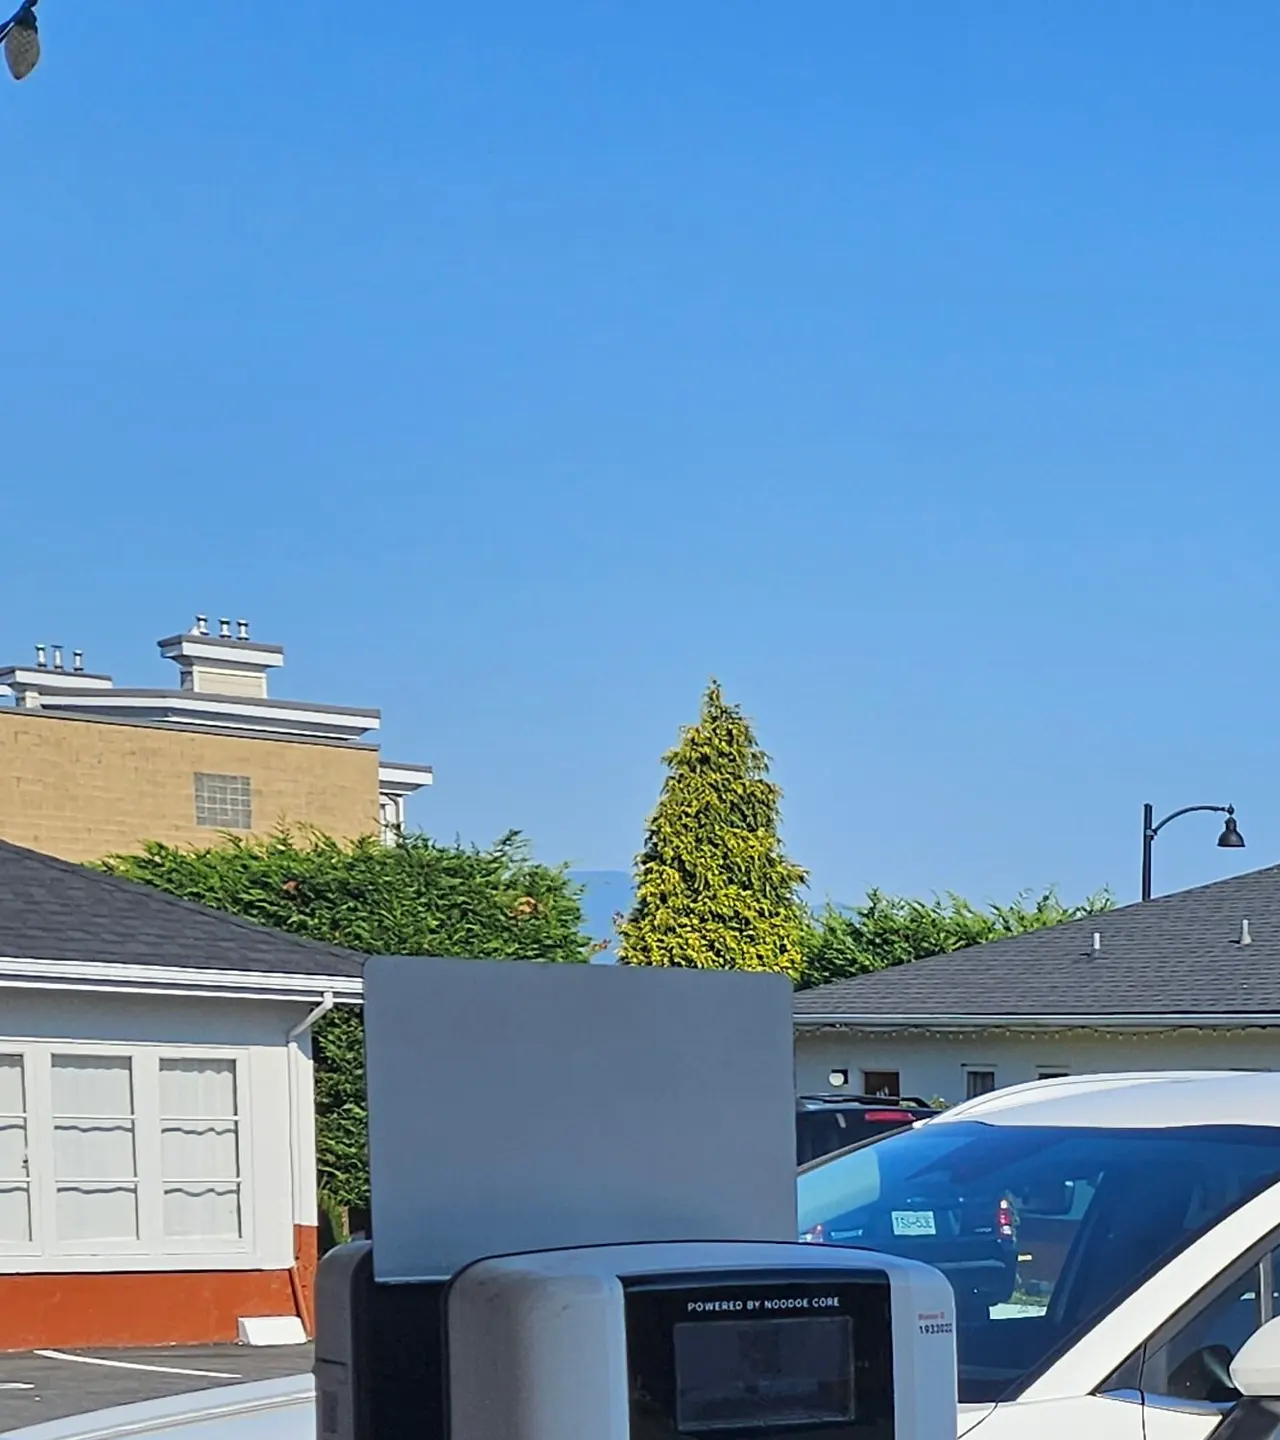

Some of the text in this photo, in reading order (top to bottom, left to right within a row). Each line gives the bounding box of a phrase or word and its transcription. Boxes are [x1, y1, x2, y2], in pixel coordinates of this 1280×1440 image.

[687, 1296, 840, 1312] POWERED BY NOODOE CORE
